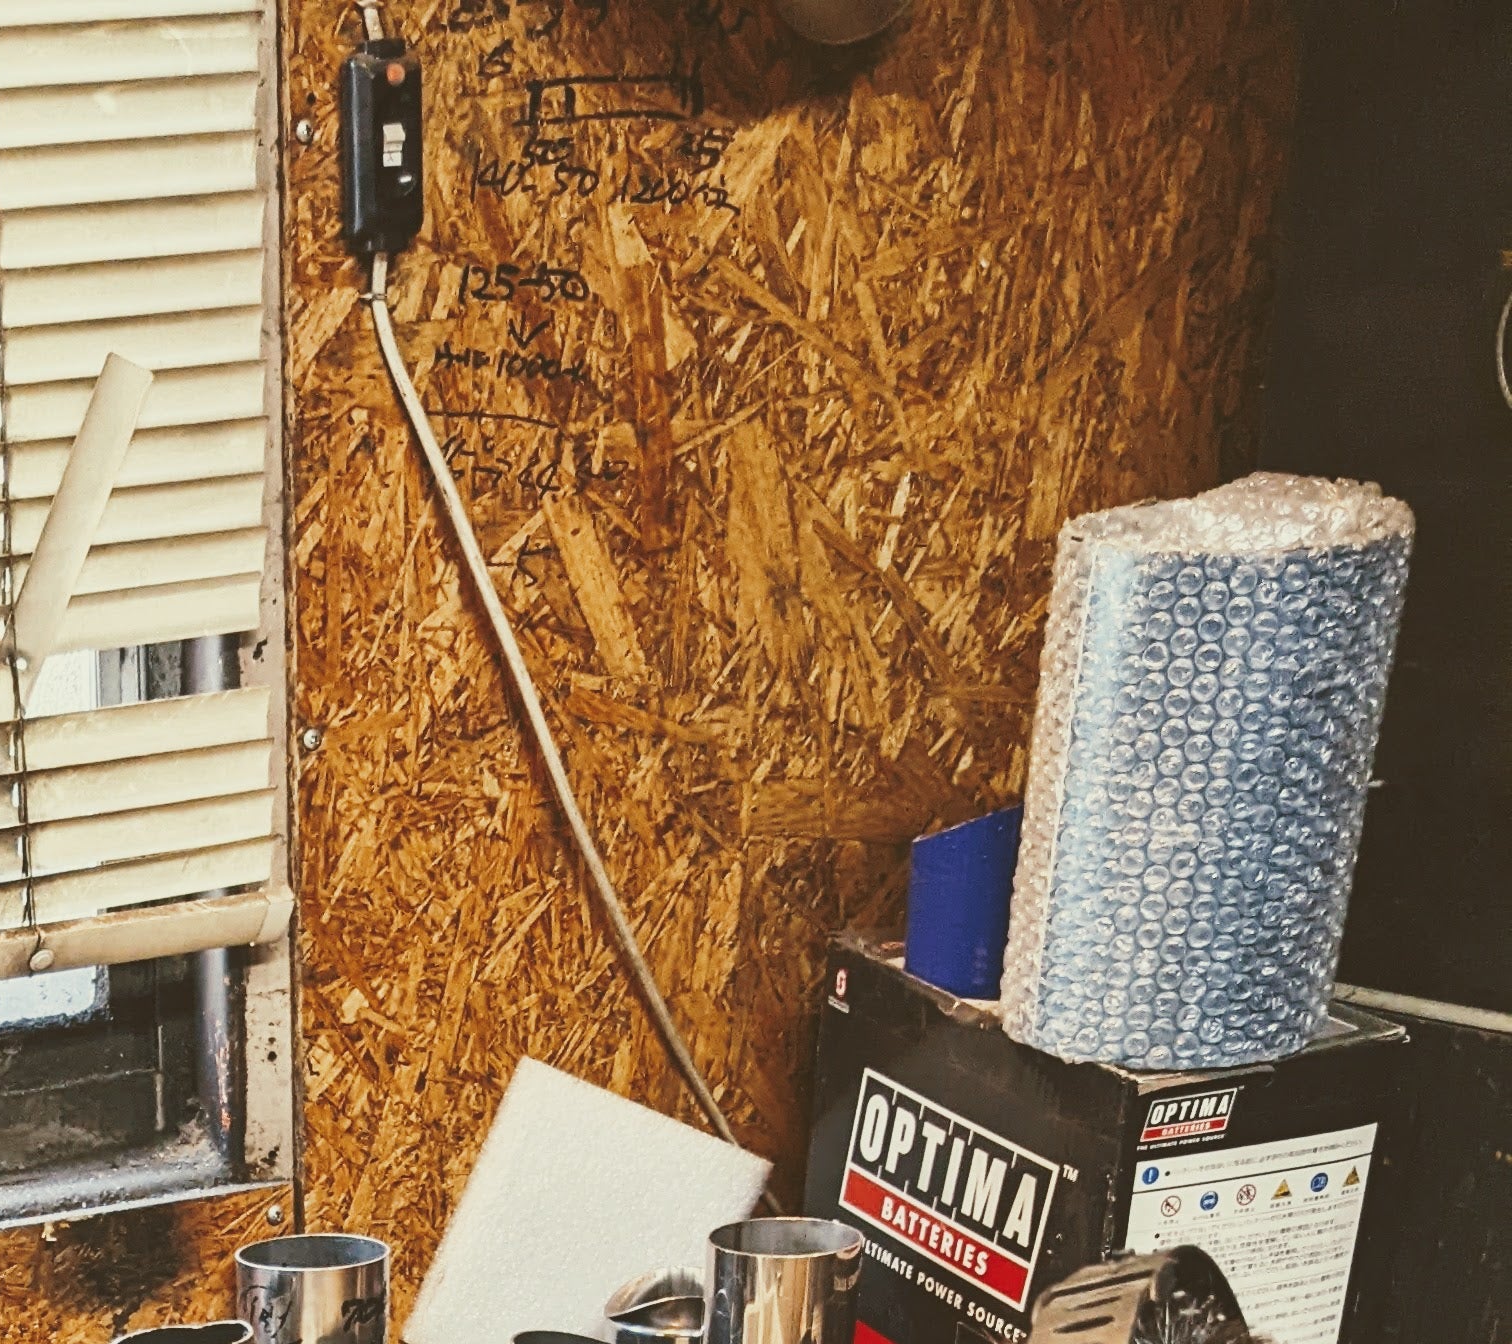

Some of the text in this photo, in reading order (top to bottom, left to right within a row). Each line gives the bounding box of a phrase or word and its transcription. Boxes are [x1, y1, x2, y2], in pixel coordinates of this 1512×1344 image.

[1150, 1094, 1230, 1125] OPTIMA
[1161, 1121, 1211, 1136] BATTERIES
[859, 1093, 1037, 1248] OPTIMA
[880, 1196, 989, 1276] BATTERIES
[862, 1237, 914, 1280] LTIMATE
[916, 1271, 964, 1310] POWER
